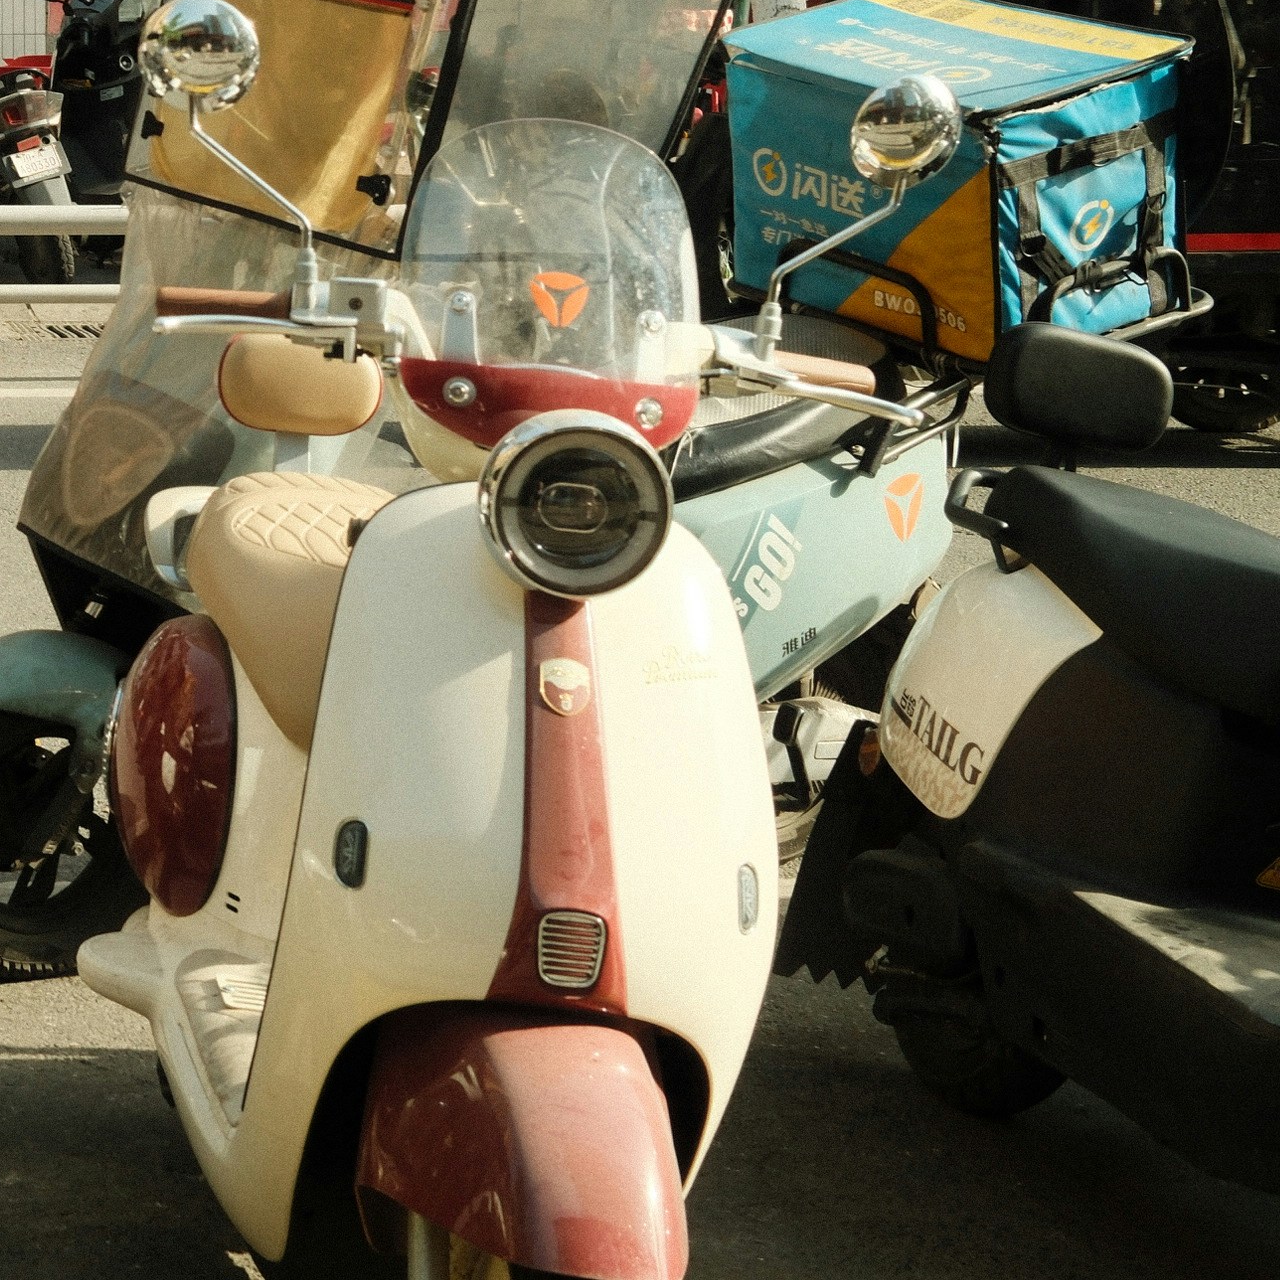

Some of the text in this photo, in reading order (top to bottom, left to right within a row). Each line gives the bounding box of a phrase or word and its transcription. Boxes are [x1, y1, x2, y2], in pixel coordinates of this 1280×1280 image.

[791, 163, 866, 219] 闪送
[743, 513, 803, 612] GO!
[781, 627, 817, 658] 雅迪
[912, 694, 985, 786] TAILG
